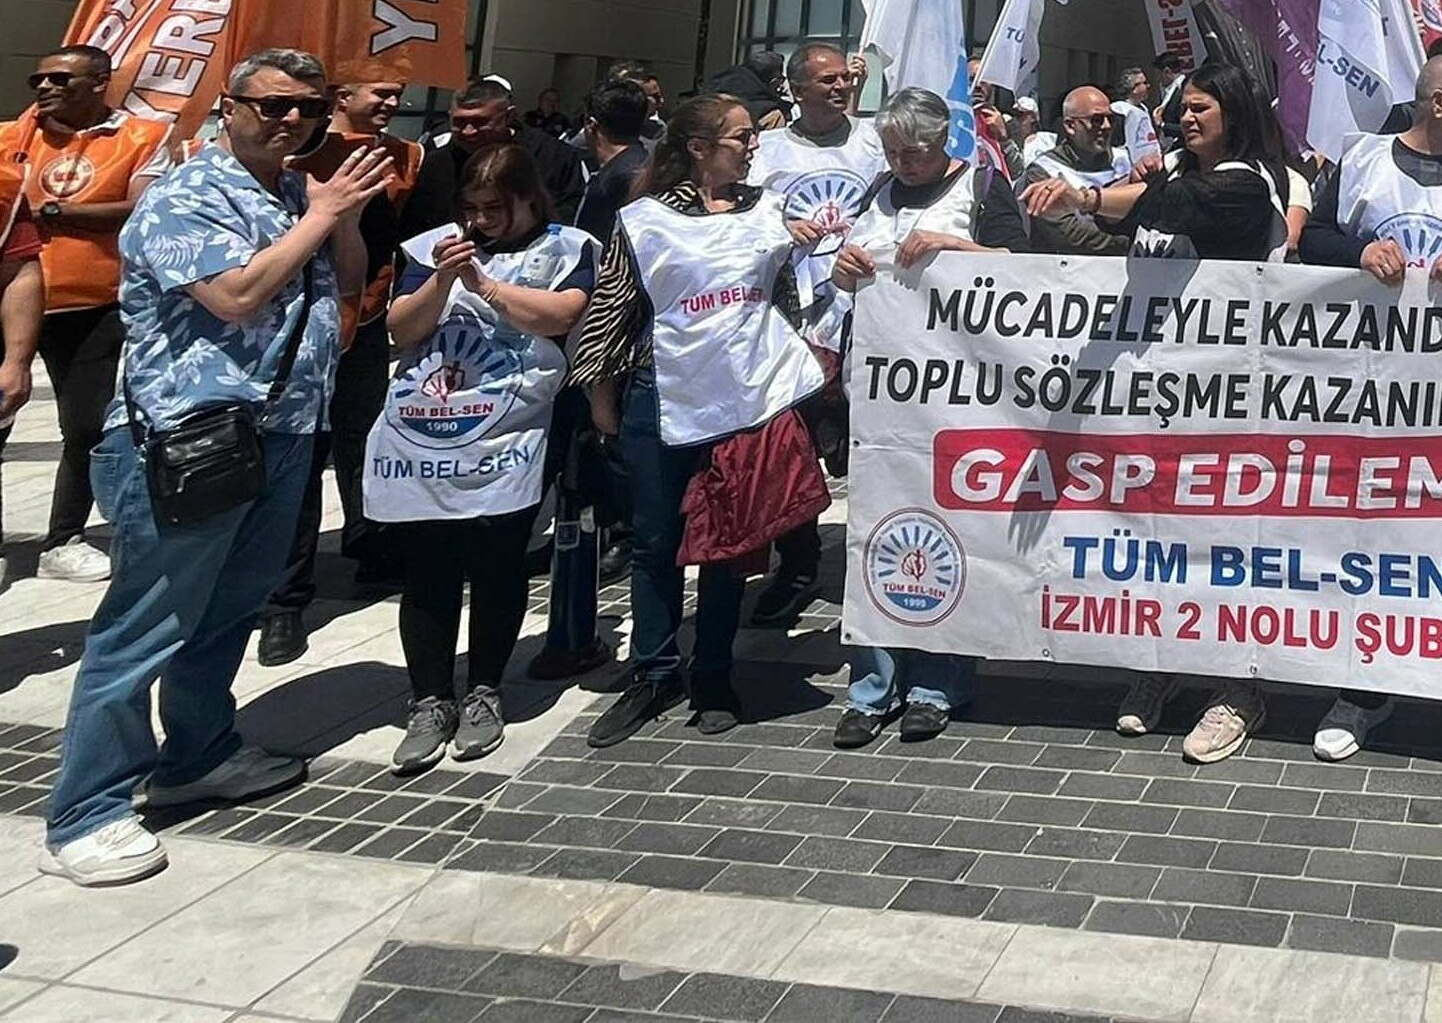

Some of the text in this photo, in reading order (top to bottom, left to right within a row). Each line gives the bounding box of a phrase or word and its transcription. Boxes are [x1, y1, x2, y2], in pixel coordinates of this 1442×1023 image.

[1317, 43, 1381, 98] L-SEN
[926, 276, 1251, 346] MÜCADELEYLE
[399, 402, 494, 417] TÜM BEL-SEN
[866, 356, 1003, 406] TOPLU
[1013, 354, 1251, 428] SÖZLEŞME
[426, 421, 458, 432] 1990
[373, 445, 530, 479] TÜM BEL-SEN
[950, 448, 1157, 505] GASP
[1063, 528, 1188, 584] TÜM
[883, 582, 904, 592] TÜM
[1041, 584, 1162, 638] İZMİR
[1176, 602, 1201, 640] 2
[1218, 604, 1340, 649] NOLU
